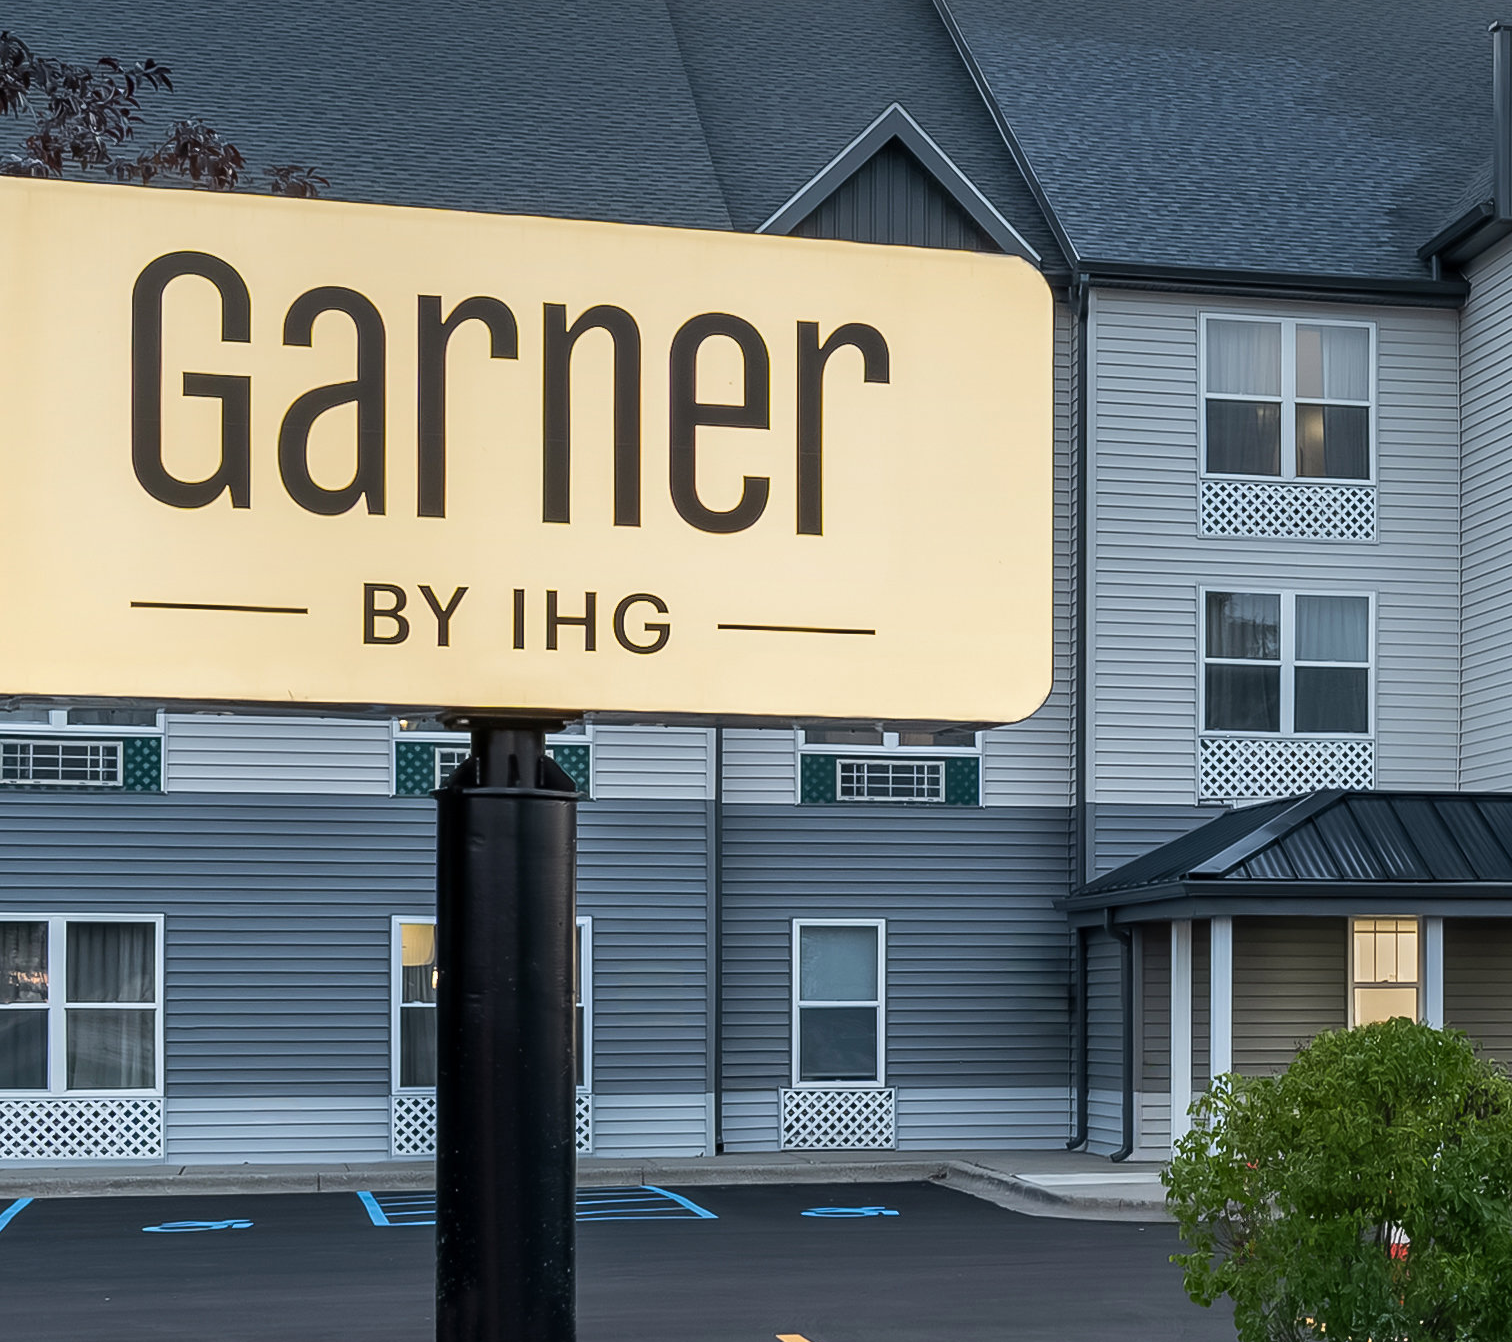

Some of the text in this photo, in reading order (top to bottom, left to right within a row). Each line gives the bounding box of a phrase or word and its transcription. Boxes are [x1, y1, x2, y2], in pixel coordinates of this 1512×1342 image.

[130, 249, 892, 538] Garner
[362, 581, 673, 656] BY IHG
